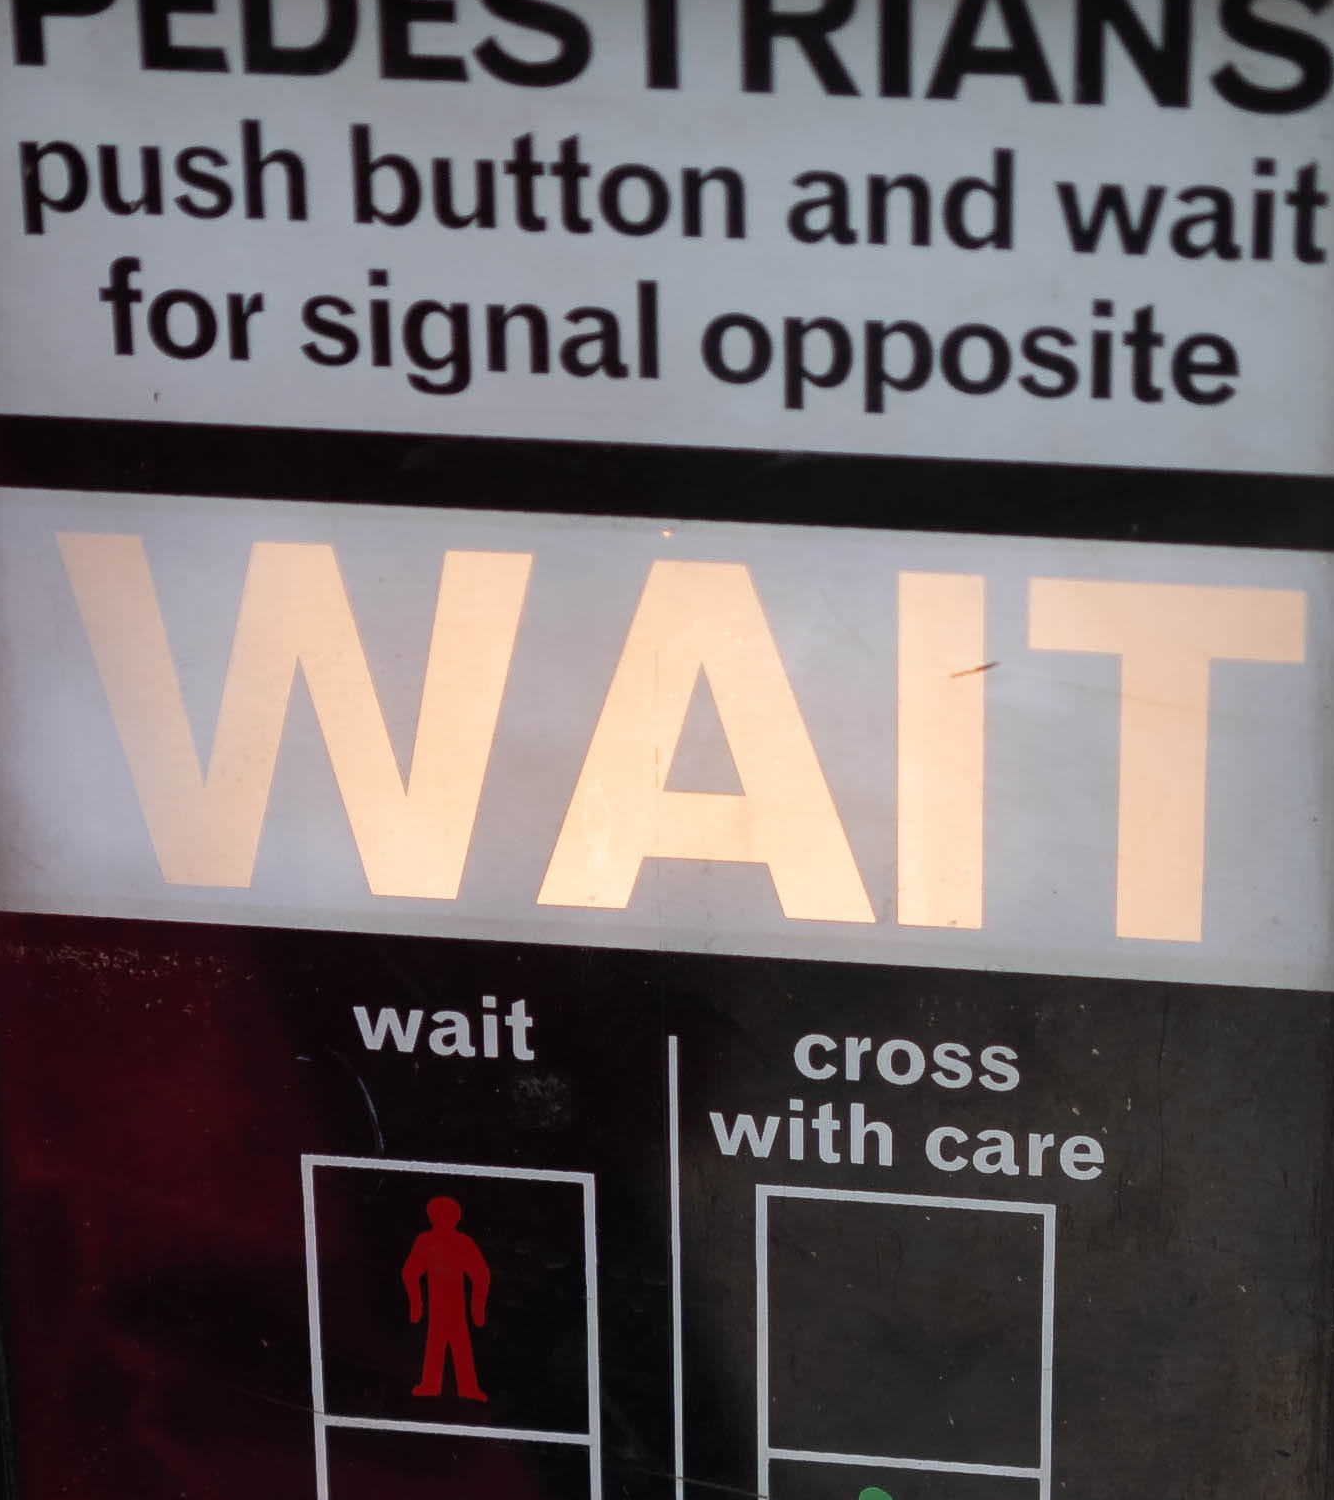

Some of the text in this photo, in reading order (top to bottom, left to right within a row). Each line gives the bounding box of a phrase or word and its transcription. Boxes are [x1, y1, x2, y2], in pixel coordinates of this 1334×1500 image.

[20, 120, 1329, 264] push button and wait
[100, 257, 1239, 413] for signal opposite
[57, 532, 1307, 942] WAIT
[353, 996, 534, 1060] wait
[794, 1034, 1020, 1091] cross
[710, 1099, 1104, 1180] with care
